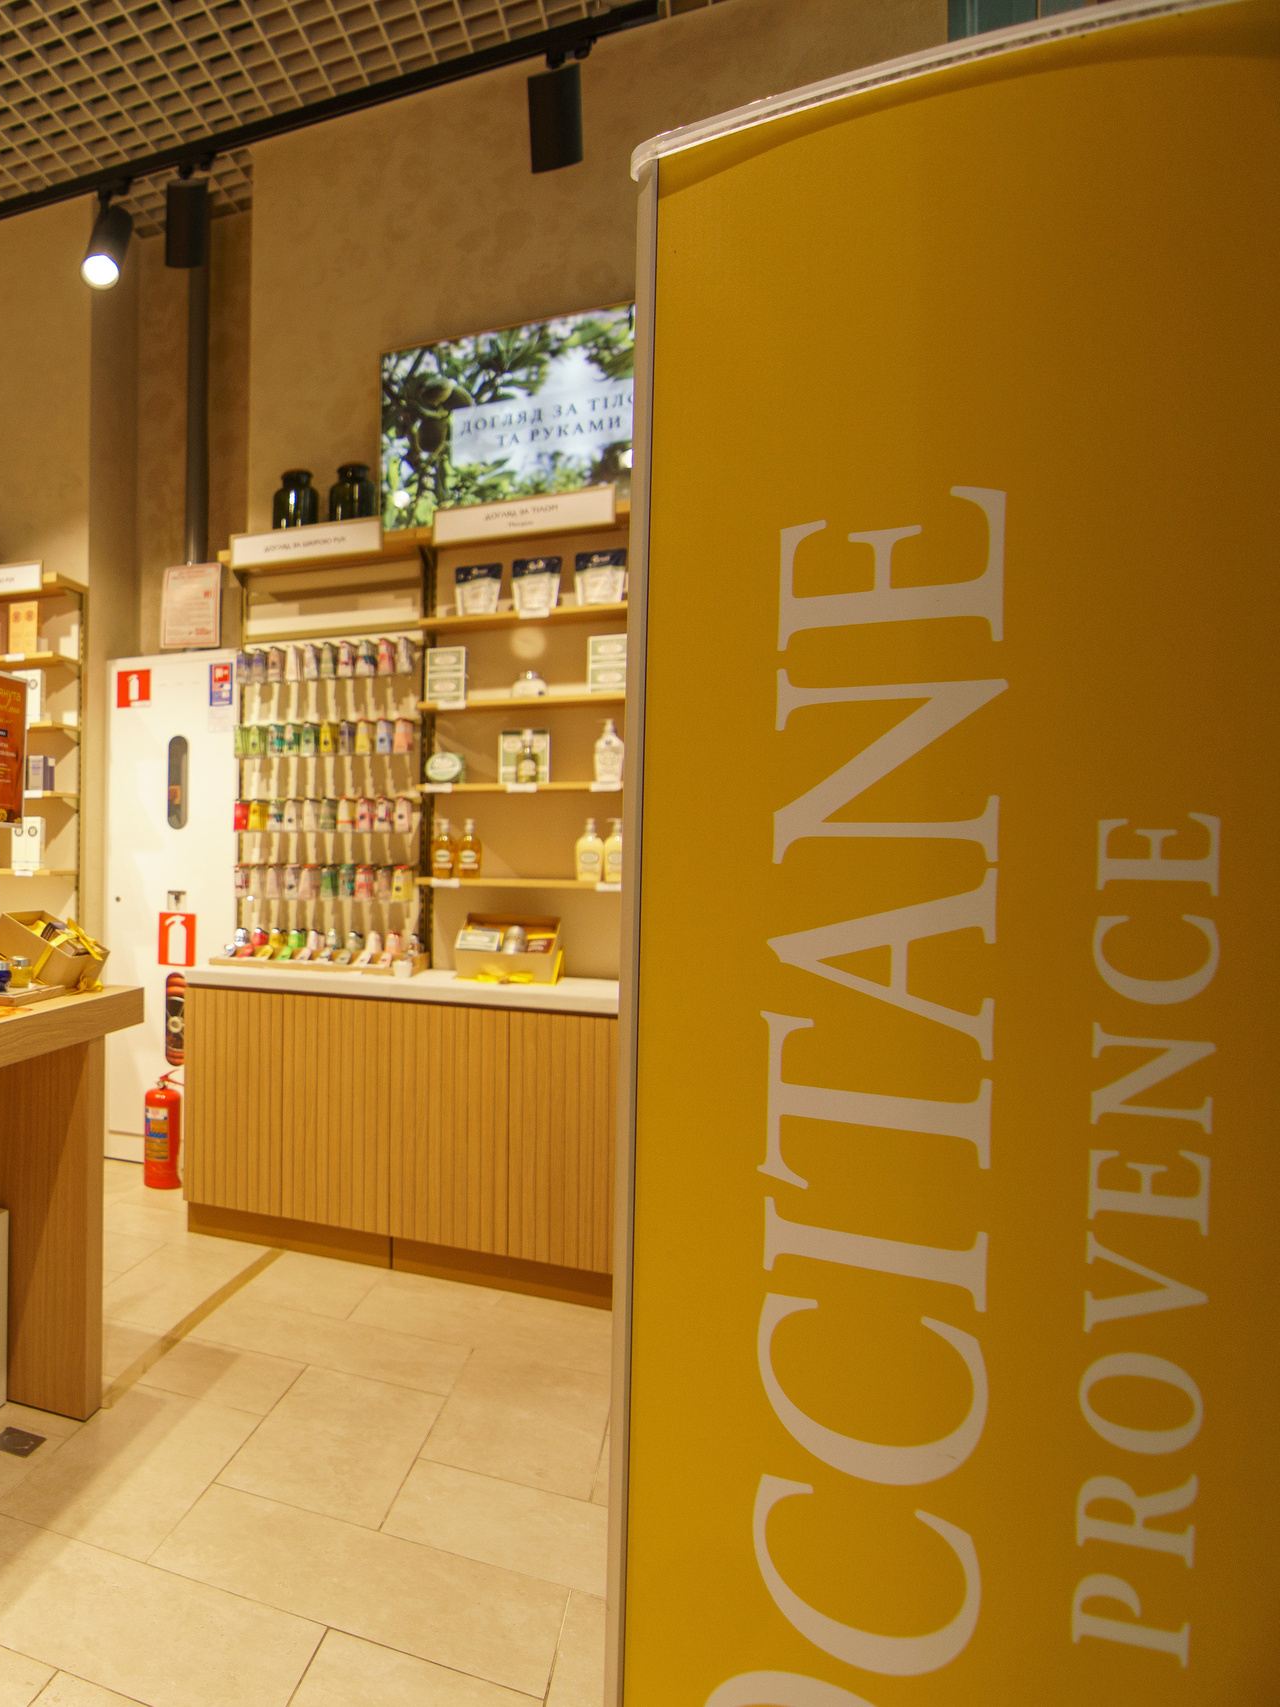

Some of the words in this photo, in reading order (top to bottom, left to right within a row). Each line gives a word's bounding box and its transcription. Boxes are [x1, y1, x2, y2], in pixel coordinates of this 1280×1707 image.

[460, 408, 543, 436] ДОГЛЯД
[553, 403, 578, 418] ЗА
[497, 434, 520, 447] ТА
[530, 416, 621, 441] РУКАМИ
[703, 484, 1009, 1707] CCITANE
[1072, 811, 1221, 1668] PROVENCE
